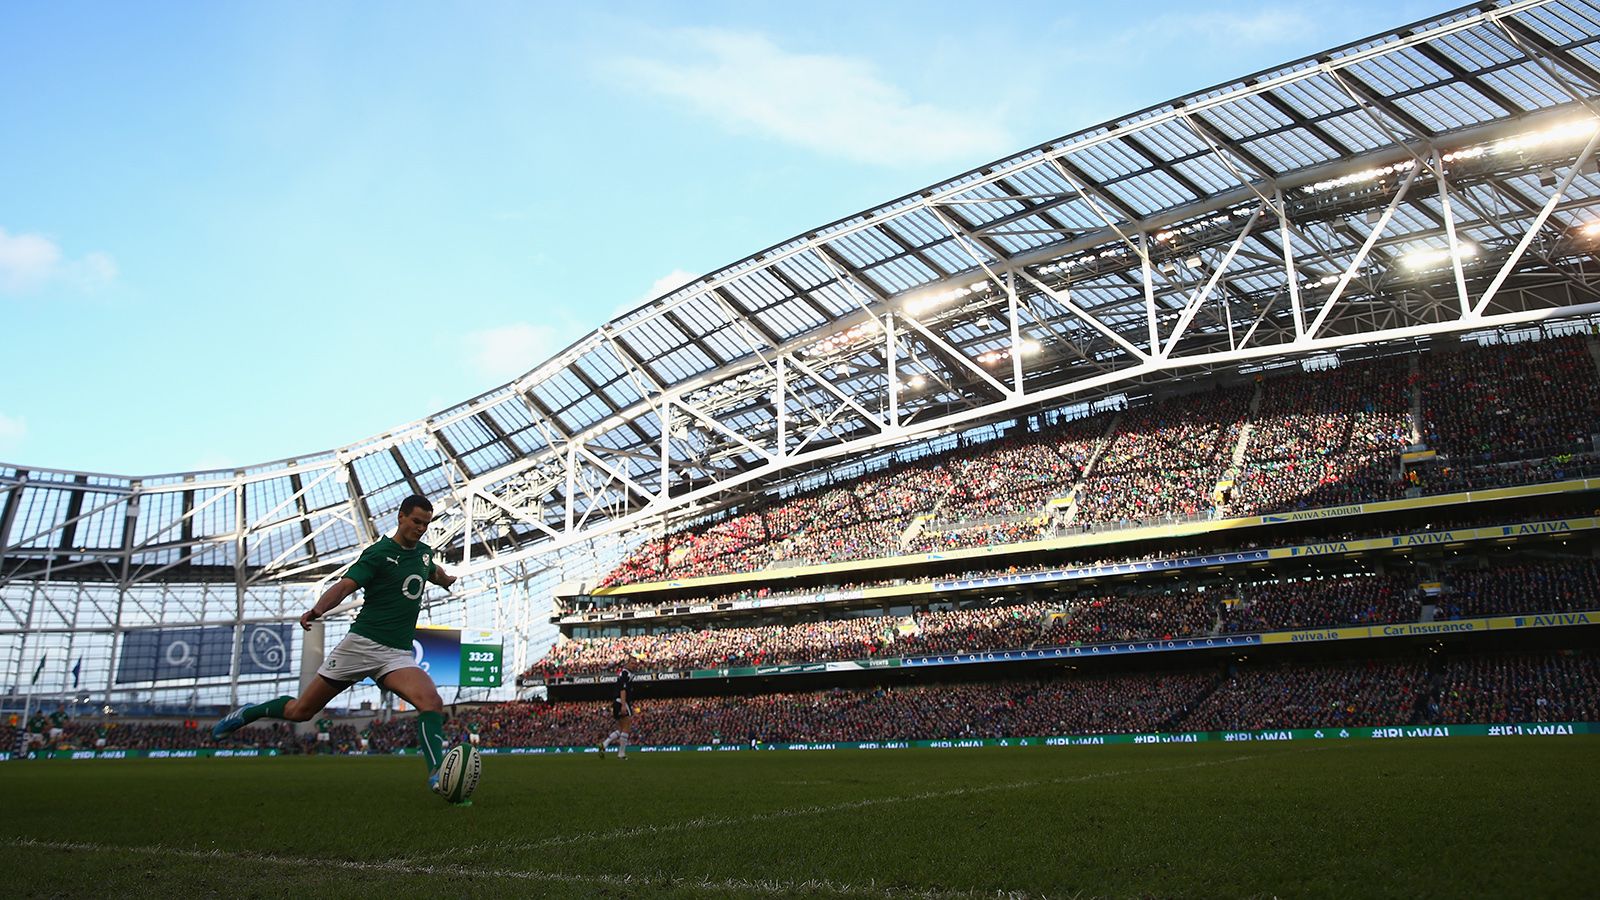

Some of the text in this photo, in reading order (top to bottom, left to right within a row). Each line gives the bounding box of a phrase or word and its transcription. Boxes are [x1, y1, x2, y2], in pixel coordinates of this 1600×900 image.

[1292, 506, 1362, 520] AVIVA STADIUM
[1519, 521, 1570, 534] AVIVA
[1407, 533, 1454, 545] AVIVA
[1305, 543, 1348, 555] AVIVA
[1533, 614, 1590, 626] AVIVA
[1384, 622, 1473, 636] Car Insurance
[1291, 630, 1338, 641] aviva.ie
[469, 652, 494, 662] 33:23
[490, 666, 498, 674] 11
[658, 672, 680, 680] GUINNESS
